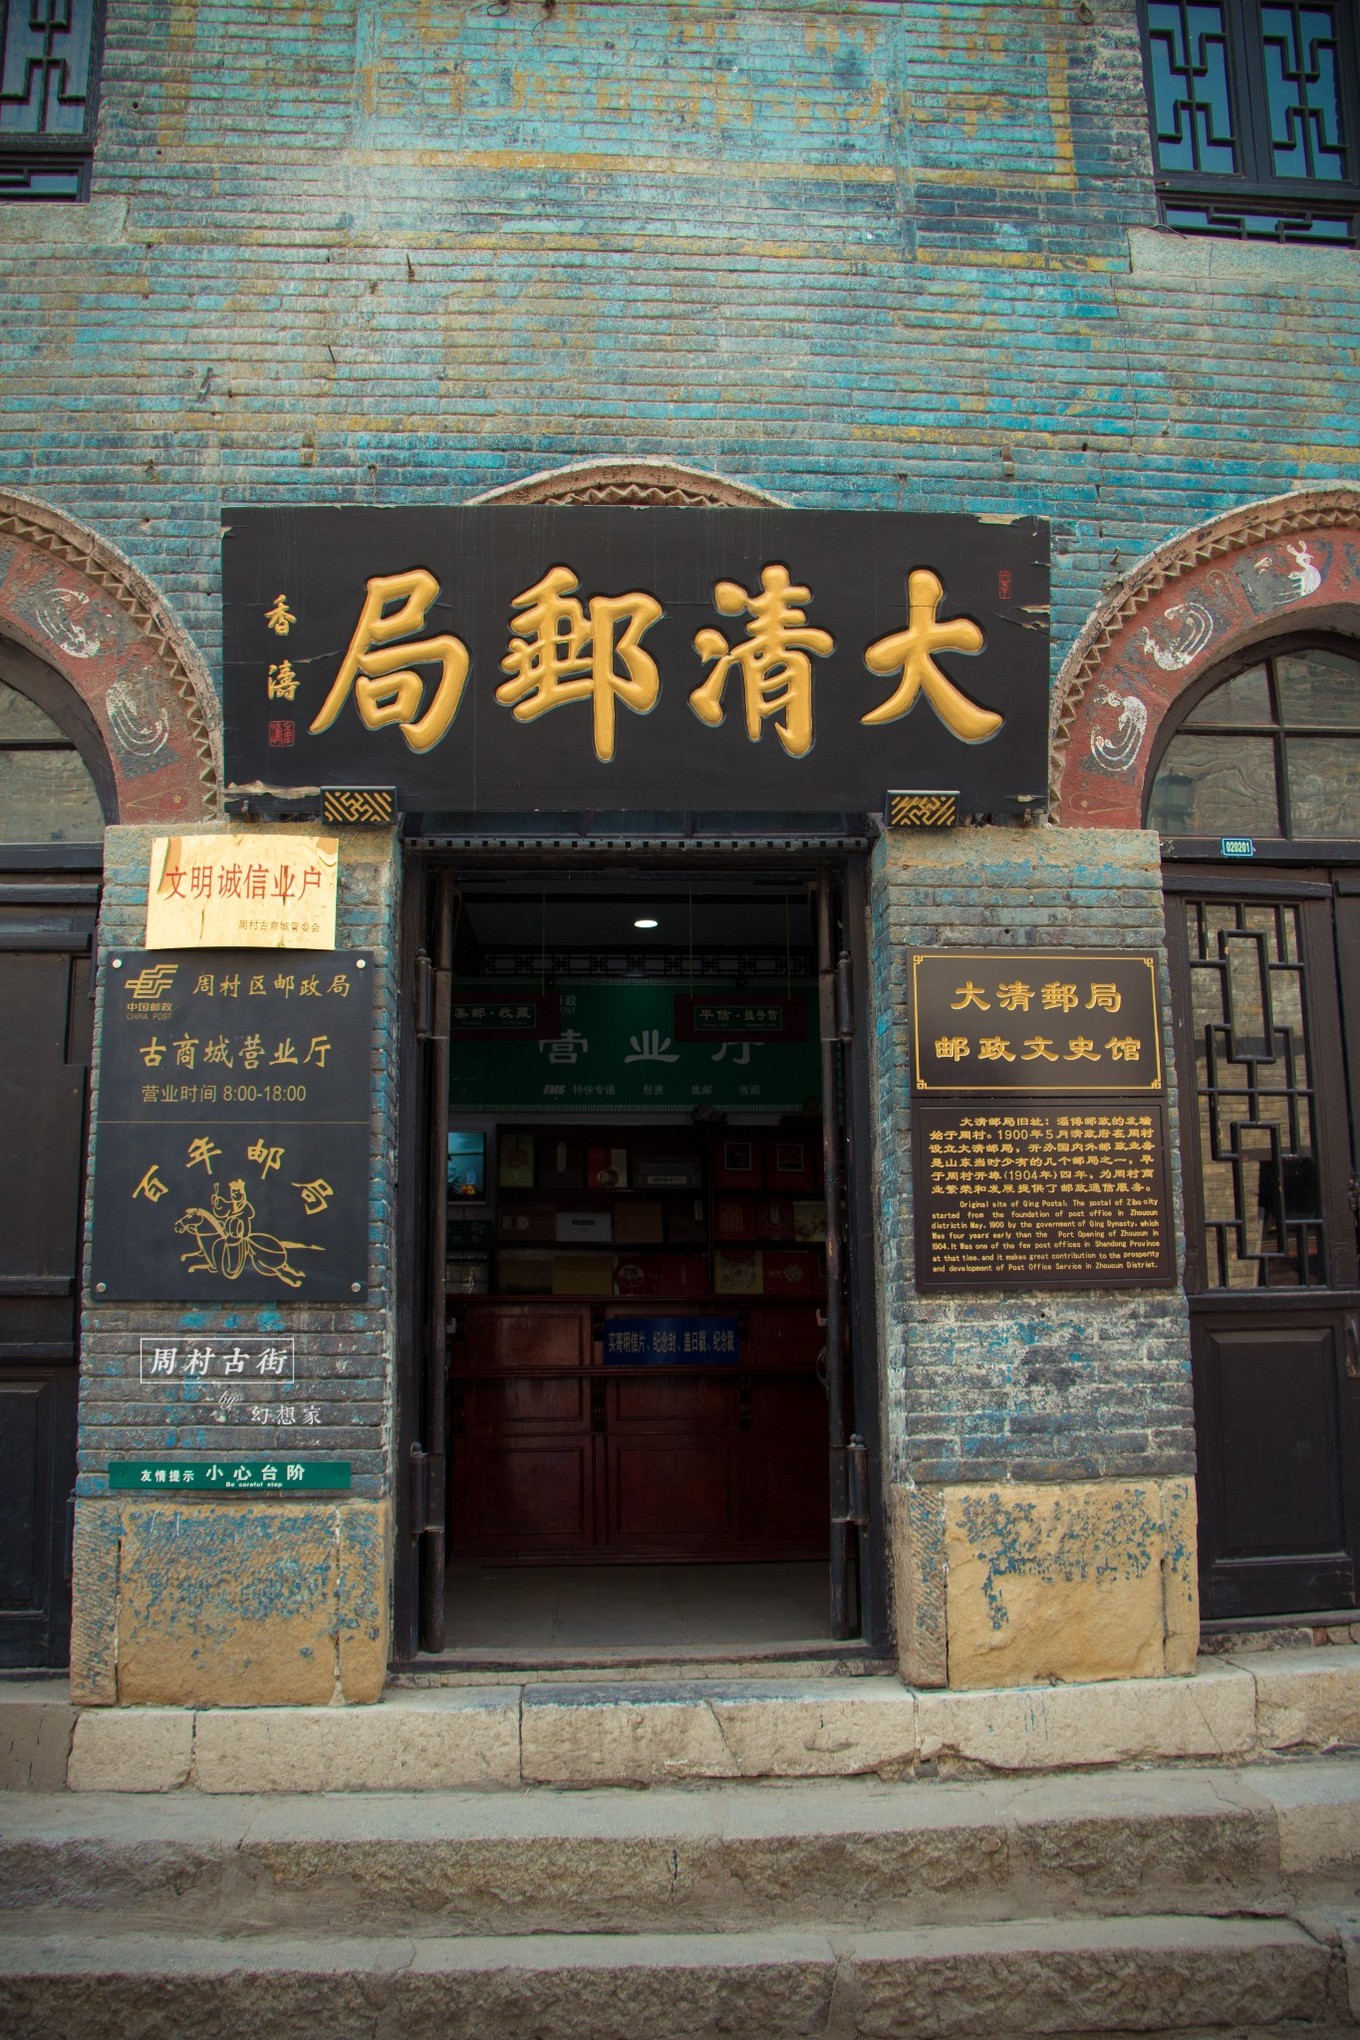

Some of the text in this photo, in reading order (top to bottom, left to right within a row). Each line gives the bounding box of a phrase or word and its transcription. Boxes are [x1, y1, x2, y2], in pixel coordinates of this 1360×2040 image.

[163, 863, 322, 901] 文明诚信业户
[239, 919, 321, 933] 周村古商城管委会
[192, 973, 350, 998] 周村区邮政局
[951, 980, 1122, 1013] 大清郵局
[127, 1002, 173, 1013] 中国邮政
[139, 1032, 332, 1070] 古商城营业厅
[934, 1035, 1142, 1062] 邮政文史馆
[141, 1085, 306, 1103] 营业时间 8:00-18:00
[131, 1136, 334, 1215] 百年邮局
[959, 1200, 989, 1209] Original
[992, 1200, 1008, 1208] site
[1011, 1199, 1019, 1208] of
[1022, 1199, 1040, 1208] Qing
[1073, 1199, 1085, 1207] The
[1089, 1198, 1112, 1208] postal
[1114, 1198, 1124, 1206] of
[1143, 1197, 1159, 1206] city
[992, 1211, 1005, 1219] the
[1011, 1210, 1050, 1218] foundation
[1055, 1210, 1064, 1218] of
[1068, 1210, 1085, 1218] post
[989, 1221, 1004, 1229] 1900
[1007, 1221, 1017, 1229] by
[1035, 1221, 1075, 1229] government
[1089, 1220, 1105, 1228] Qing
[949, 1231, 965, 1239] four
[992, 1232, 1012, 1240] early
[1077, 1230, 1105, 1238] Opening
[990, 1242, 1000, 1250] of
[1002, 1242, 1015, 1250] the
[1034, 1241, 1051, 1249] post
[1054, 1240, 1081, 1248] offices
[1084, 1240, 1091, 1248] in
[1094, 1240, 1127, 1248] Shandong
[1129, 1239, 1160, 1247] Province
[943, 1254, 961, 1262] that
[996, 1253, 1003, 1261] it
[1029, 1252, 1049, 1260] great
[932, 1265, 946, 1273] and
[948, 1264, 993, 1273] development
[995, 1264, 1005, 1272] of
[1008, 1263, 1025, 1271] Post
[1028, 1262, 1052, 1271] Office
[1085, 1262, 1092, 1270] in
[140, 1464, 306, 1482] 友情提示 小心台阶
